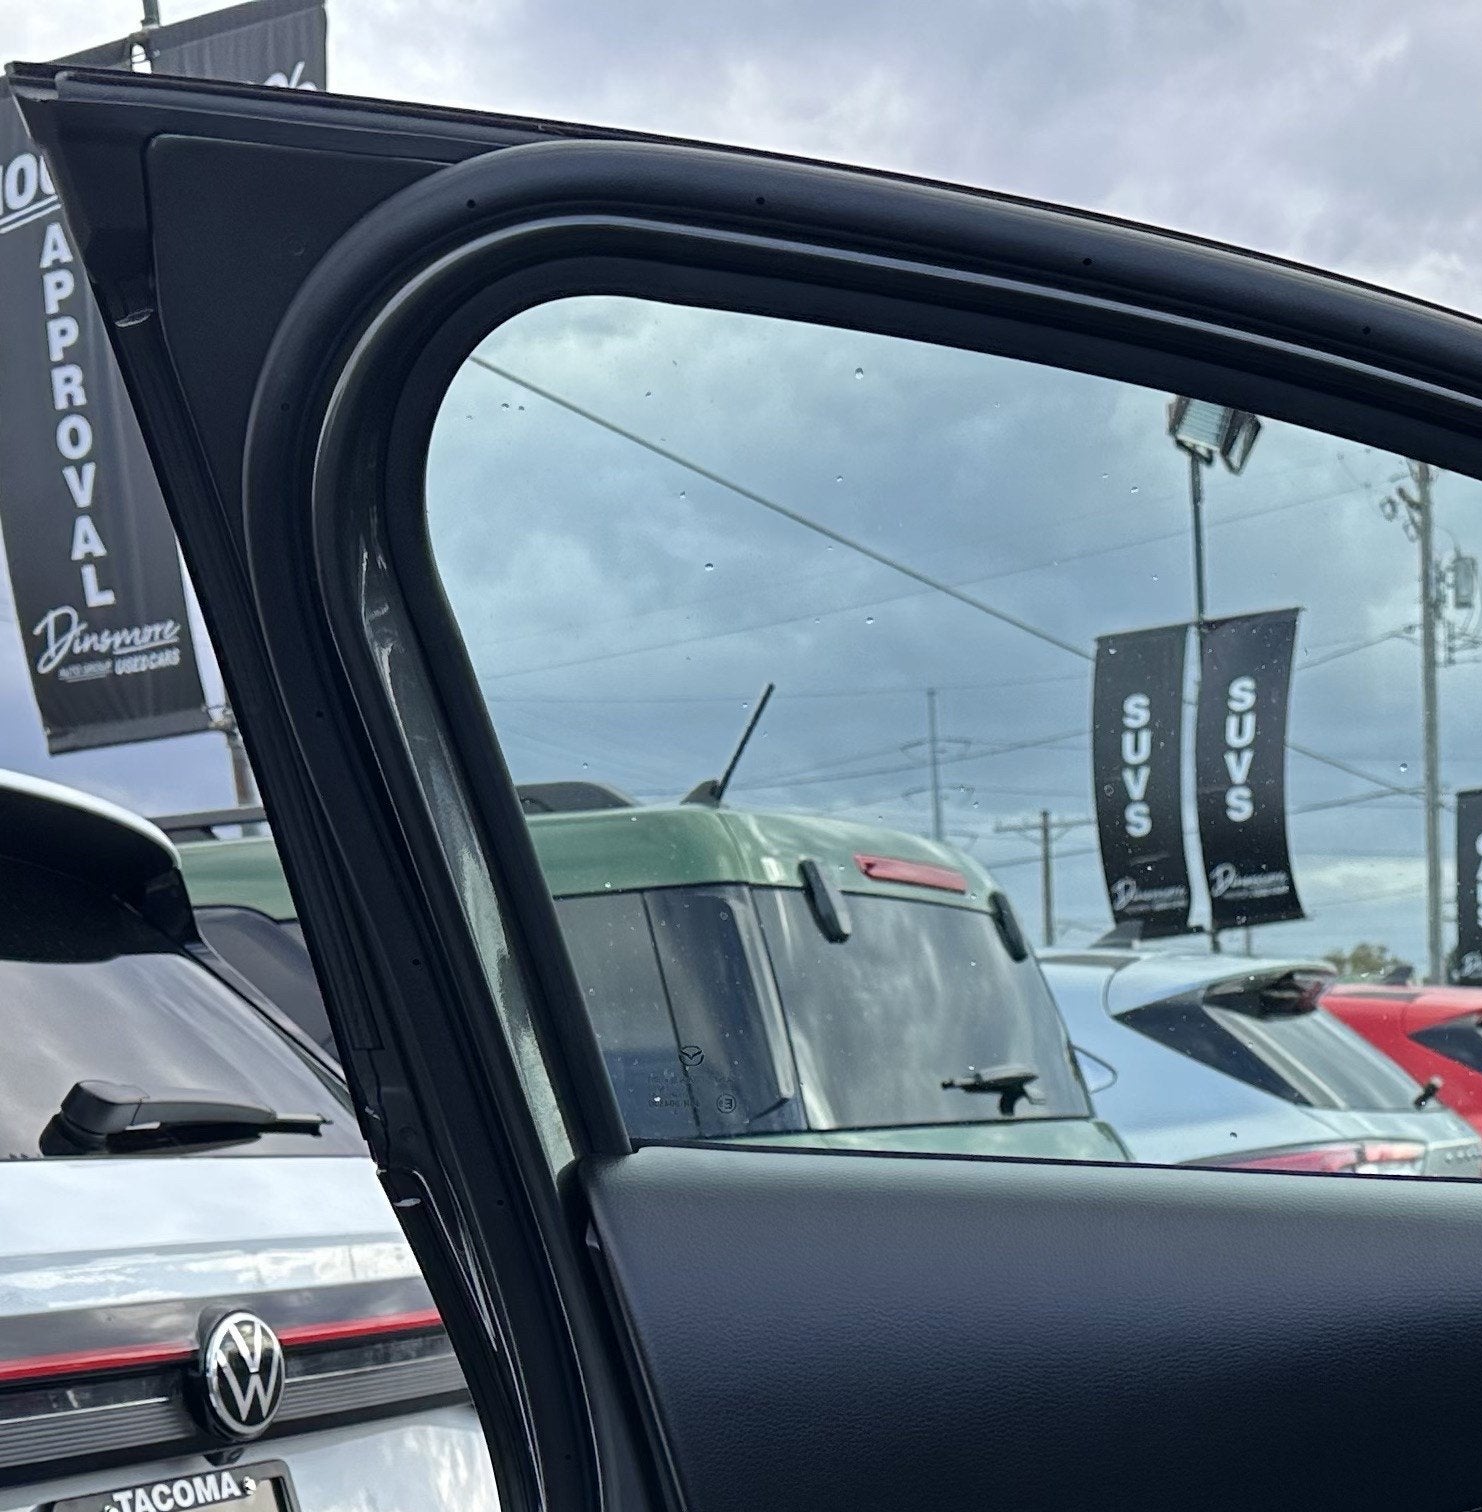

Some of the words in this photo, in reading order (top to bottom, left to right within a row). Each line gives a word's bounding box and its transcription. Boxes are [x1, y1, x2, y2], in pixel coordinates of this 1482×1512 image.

[40, 222, 116, 607] APPROVAL
[33, 605, 181, 674] Dinsmore
[1121, 692, 1152, 838] SUVS
[1224, 675, 1257, 822] SUVS
